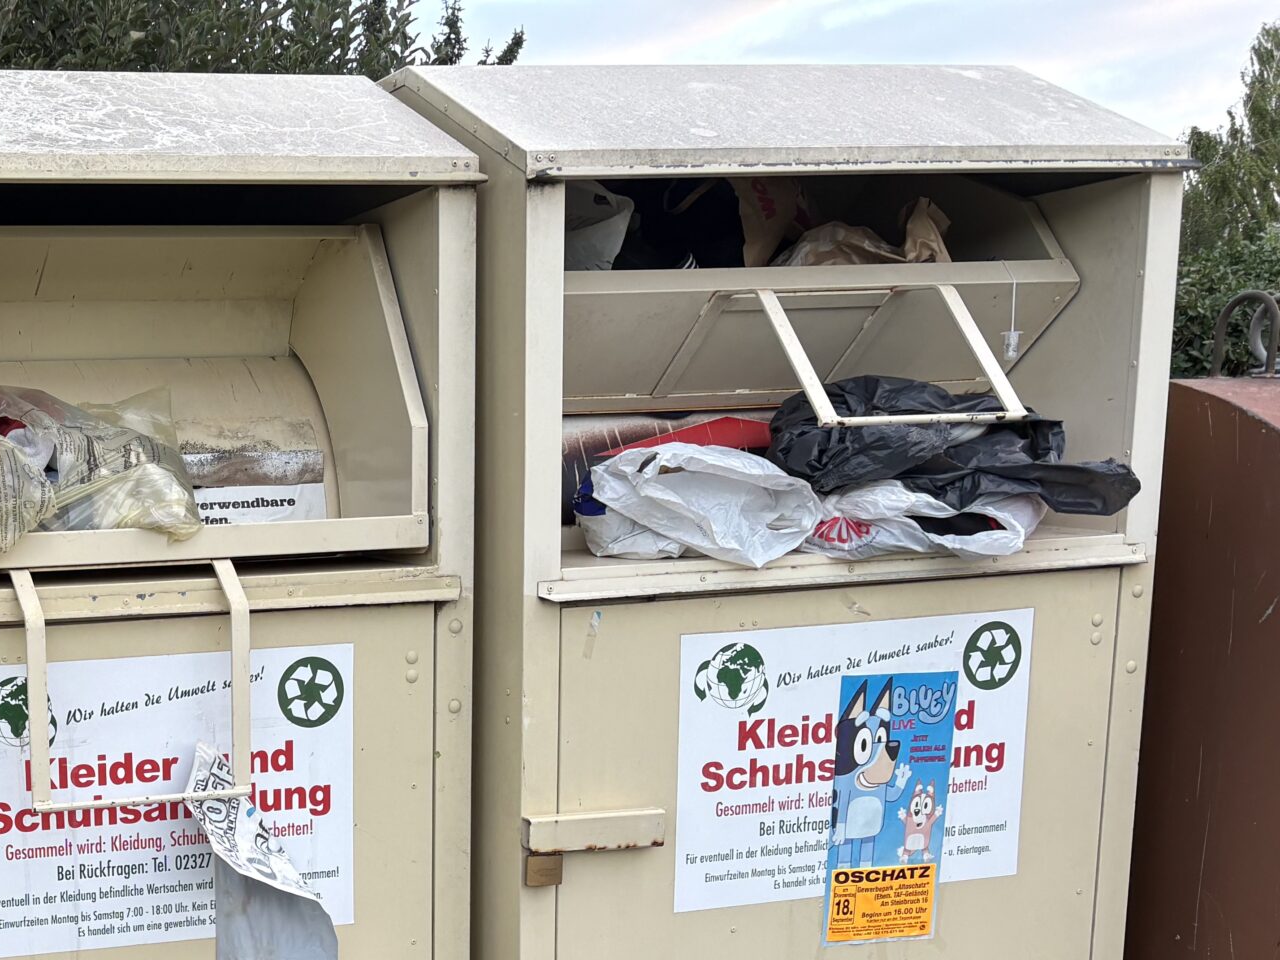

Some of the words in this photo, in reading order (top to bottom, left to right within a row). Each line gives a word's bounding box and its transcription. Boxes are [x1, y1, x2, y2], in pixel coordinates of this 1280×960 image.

[776, 671, 802, 688] Wir
[806, 664, 841, 680] halten
[846, 657, 862, 671] die
[867, 644, 911, 665] Umwelt
[915, 630, 955, 653] sauber!
[66, 707, 94, 726] Wir
[100, 701, 139, 718] halten
[145, 693, 162, 708] die
[168, 680, 217, 702] Umwelt
[891, 681, 957, 725] BLUEY
[892, 719, 916, 731] LIVE
[716, 795, 775, 818] Gesammelt
[778, 792, 804, 811] wird:
[760, 821, 775, 837] Bei
[5, 838, 73, 861] Gesammelt
[77, 835, 106, 855] wird:
[111, 833, 166, 853] Kleidung,
[685, 853, 697, 865] Für
[700, 848, 734, 863] eventuell
[736, 848, 743, 860] in
[745, 846, 758, 859] der
[760, 844, 793, 857] Kleidung
[958, 820, 1007, 836] übernommen!
[57, 864, 75, 881] Bei
[79, 857, 149, 880] Rückfragen:
[152, 855, 171, 873] Tel.
[174, 853, 213, 872] 02327
[705, 870, 749, 883] Einwurfzeiten
[751, 868, 776, 879] Montag
[777, 866, 787, 876] bis
[789, 864, 816, 875] Samstag
[834, 866, 931, 885] OSCHATZ
[32, 894, 41, 906] in
[43, 891, 57, 904] der
[60, 888, 97, 903] Kleidung
[99, 883, 144, 900] befindliche
[146, 880, 194, 895] Wertsachen
[196, 877, 214, 891] wird
[774, 880, 781, 889] Es
[782, 877, 807, 888] handelt
[808, 875, 821, 886] sich
[51, 914, 79, 925] Montag
[81, 911, 92, 922] bis
[94, 910, 124, 921] Samstag
[126, 906, 144, 918] 7:00
[151, 903, 173, 916] 18:00
[175, 902, 190, 912] Uhr.
[192, 901, 208, 912] Kein
[835, 899, 853, 916] 18.
[916, 906, 928, 914] Uhr
[78, 927, 86, 937] Es
[87, 923, 115, 936] handelt
[117, 922, 131, 934] sich
[133, 924, 145, 932] um
[146, 920, 162, 931] eine
[164, 915, 207, 932] gewerbliche
